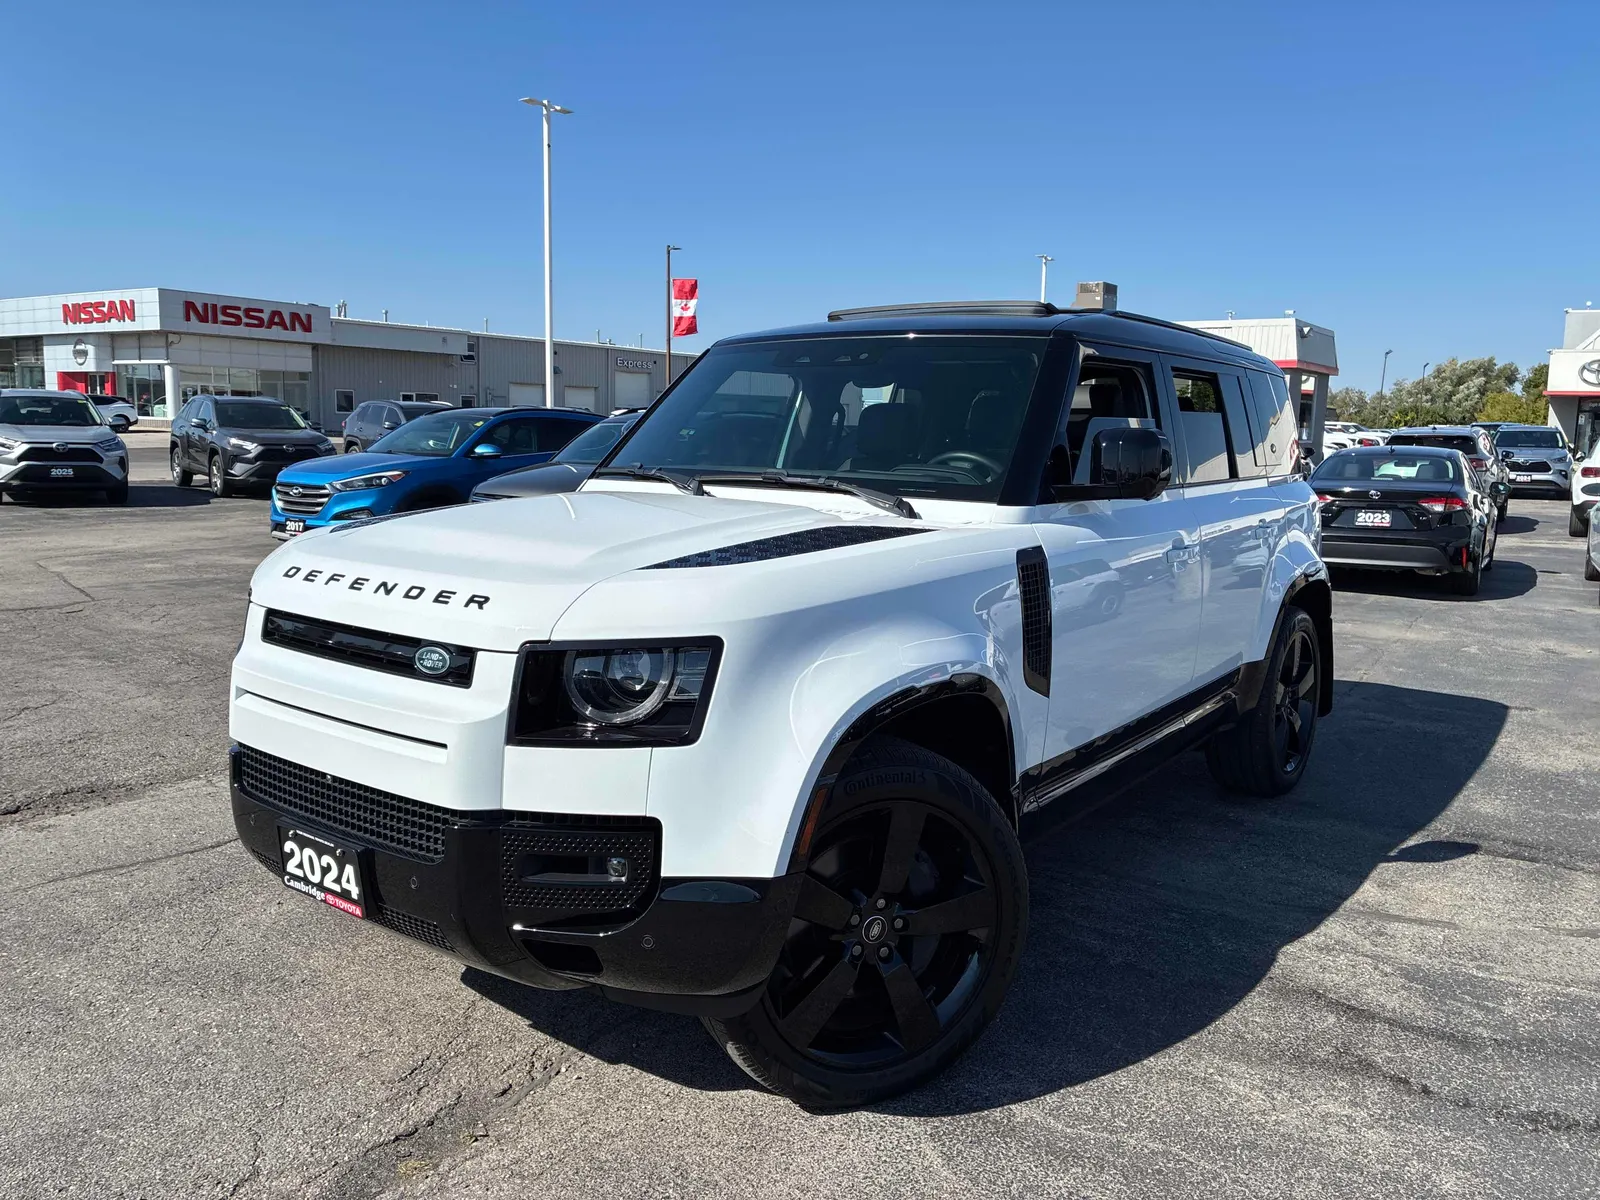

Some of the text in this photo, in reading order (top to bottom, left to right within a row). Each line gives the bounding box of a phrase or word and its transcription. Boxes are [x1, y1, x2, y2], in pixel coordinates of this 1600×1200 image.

[62, 299, 136, 325] NISSAN
[184, 300, 312, 333] NISSAN
[617, 357, 653, 369] Express
[286, 520, 304, 531] 2017
[1356, 512, 1391, 523] 2023
[282, 565, 491, 610] DEFENDER
[422, 652, 440, 661] LAND
[422, 659, 443, 669] ROVER
[844, 769, 916, 795] Continental
[283, 840, 360, 900] 2024
[283, 875, 362, 917] Cambridge TOYOTA
